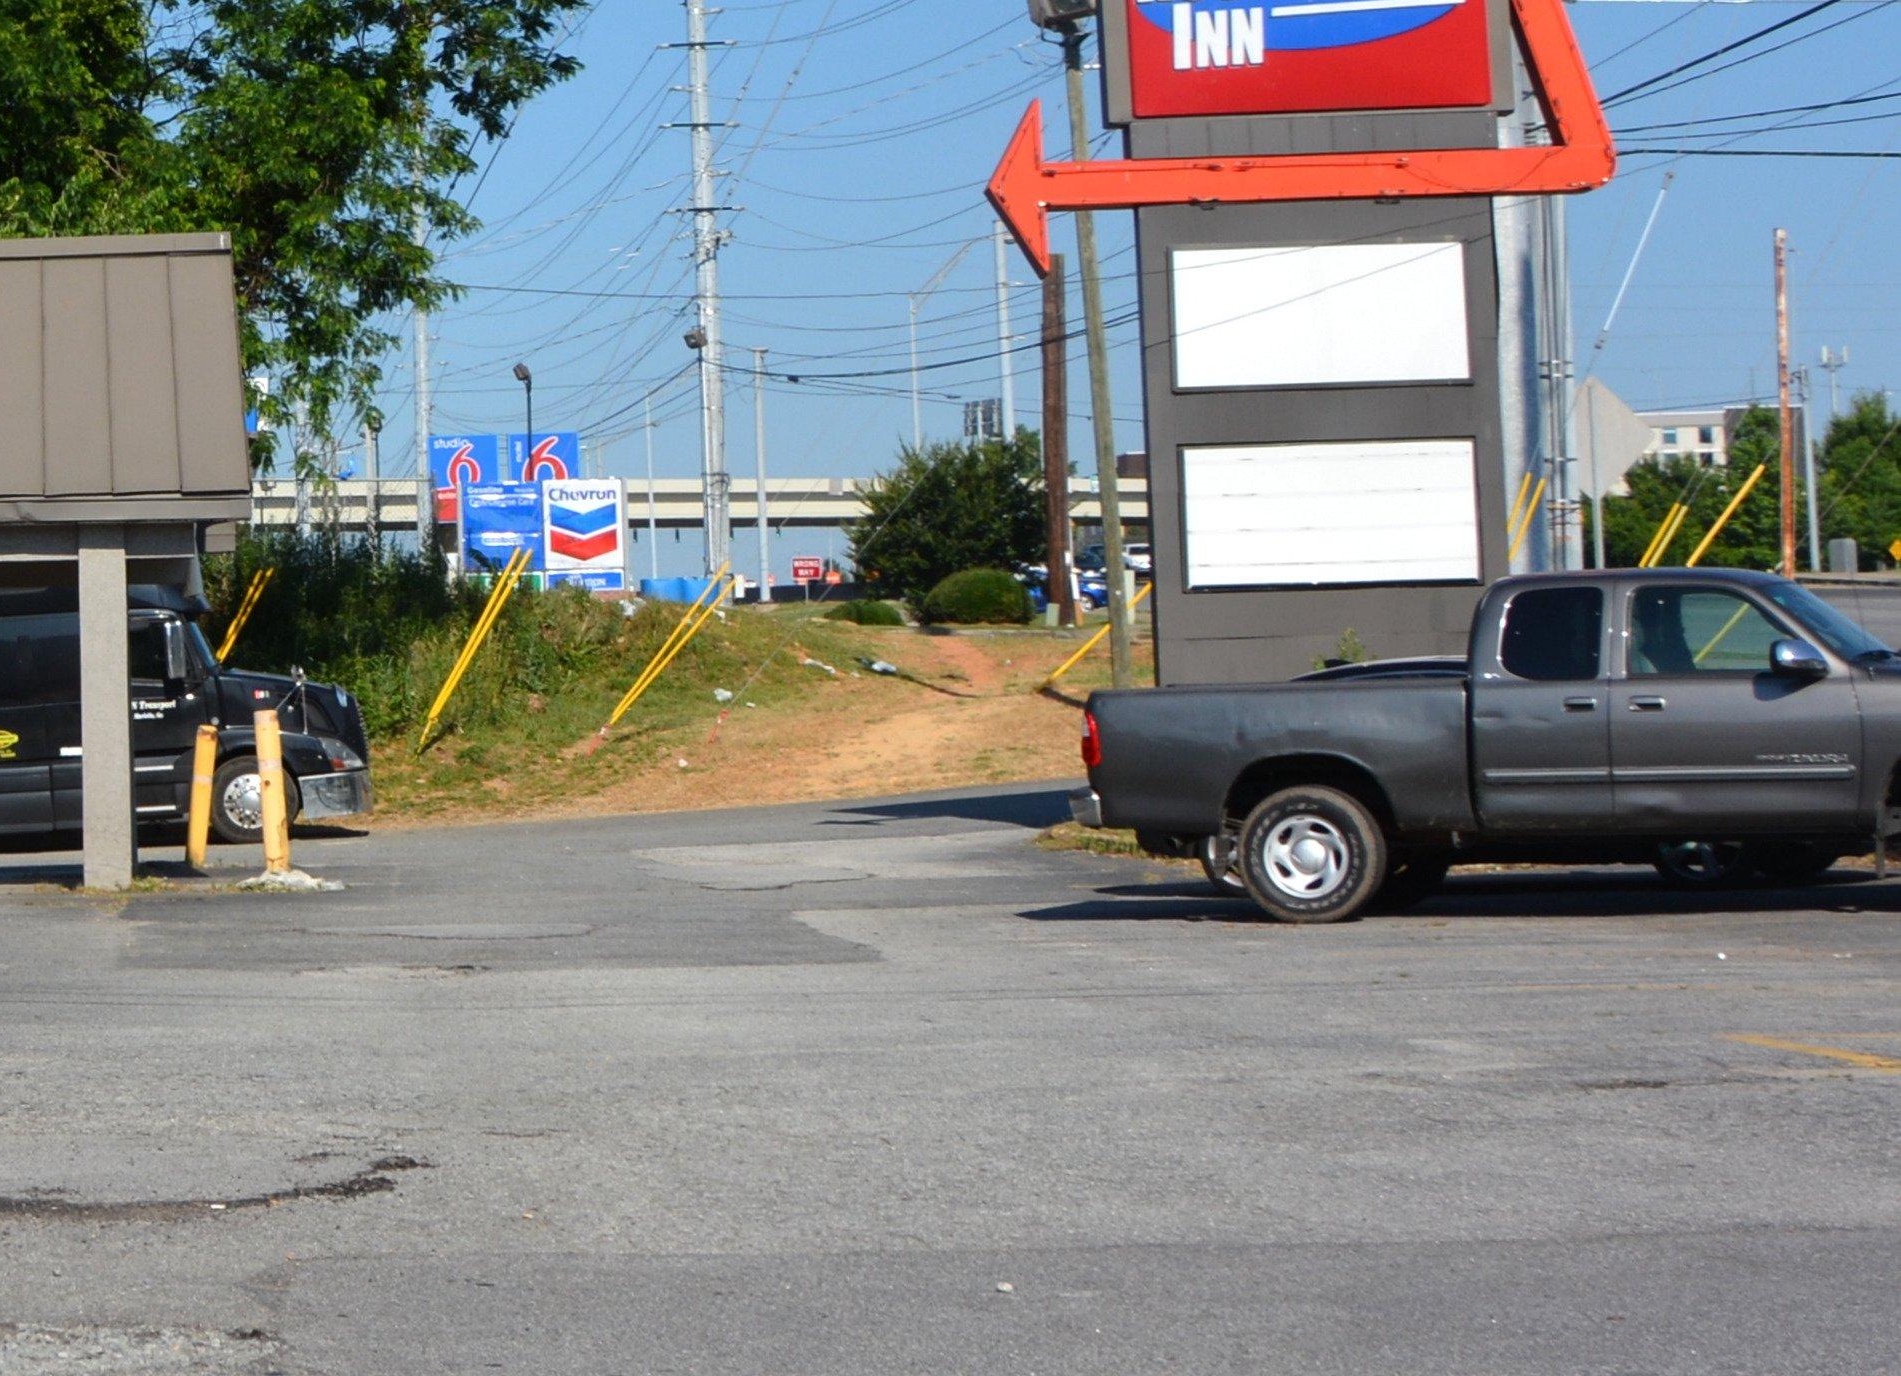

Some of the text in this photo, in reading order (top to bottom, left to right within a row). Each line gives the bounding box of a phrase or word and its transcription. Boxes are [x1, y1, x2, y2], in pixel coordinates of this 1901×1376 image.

[1173, 3, 1264, 70] INN
[433, 438, 469, 449] studio
[446, 443, 481, 487] 6
[521, 435, 569, 483] 6
[549, 488, 616, 502] Chevron
